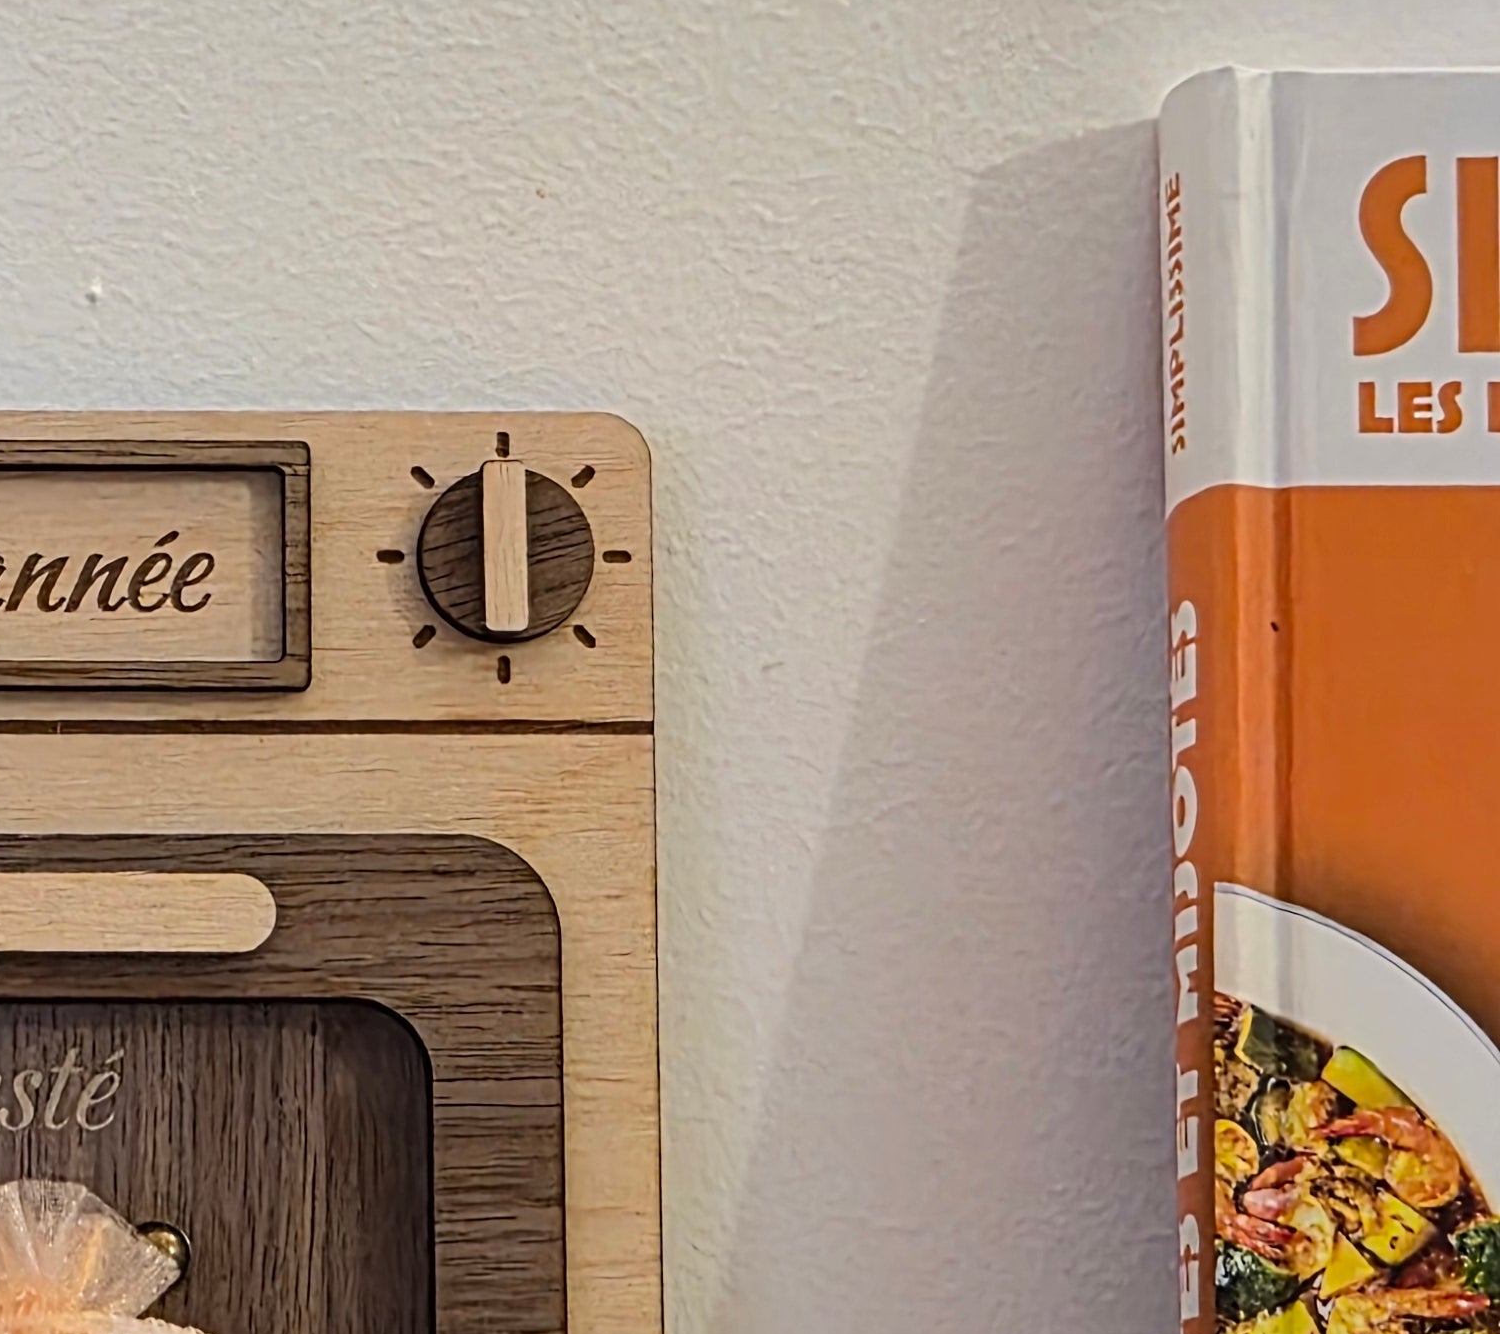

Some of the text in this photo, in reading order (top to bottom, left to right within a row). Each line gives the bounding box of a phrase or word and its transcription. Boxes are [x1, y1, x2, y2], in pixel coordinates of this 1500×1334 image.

[1164, 172, 1187, 456] SIMPLISSIME
[1352, 154, 1500, 356] SI
[1358, 381, 1463, 434] LES
[1175, 1063, 1200, 1180] ET
